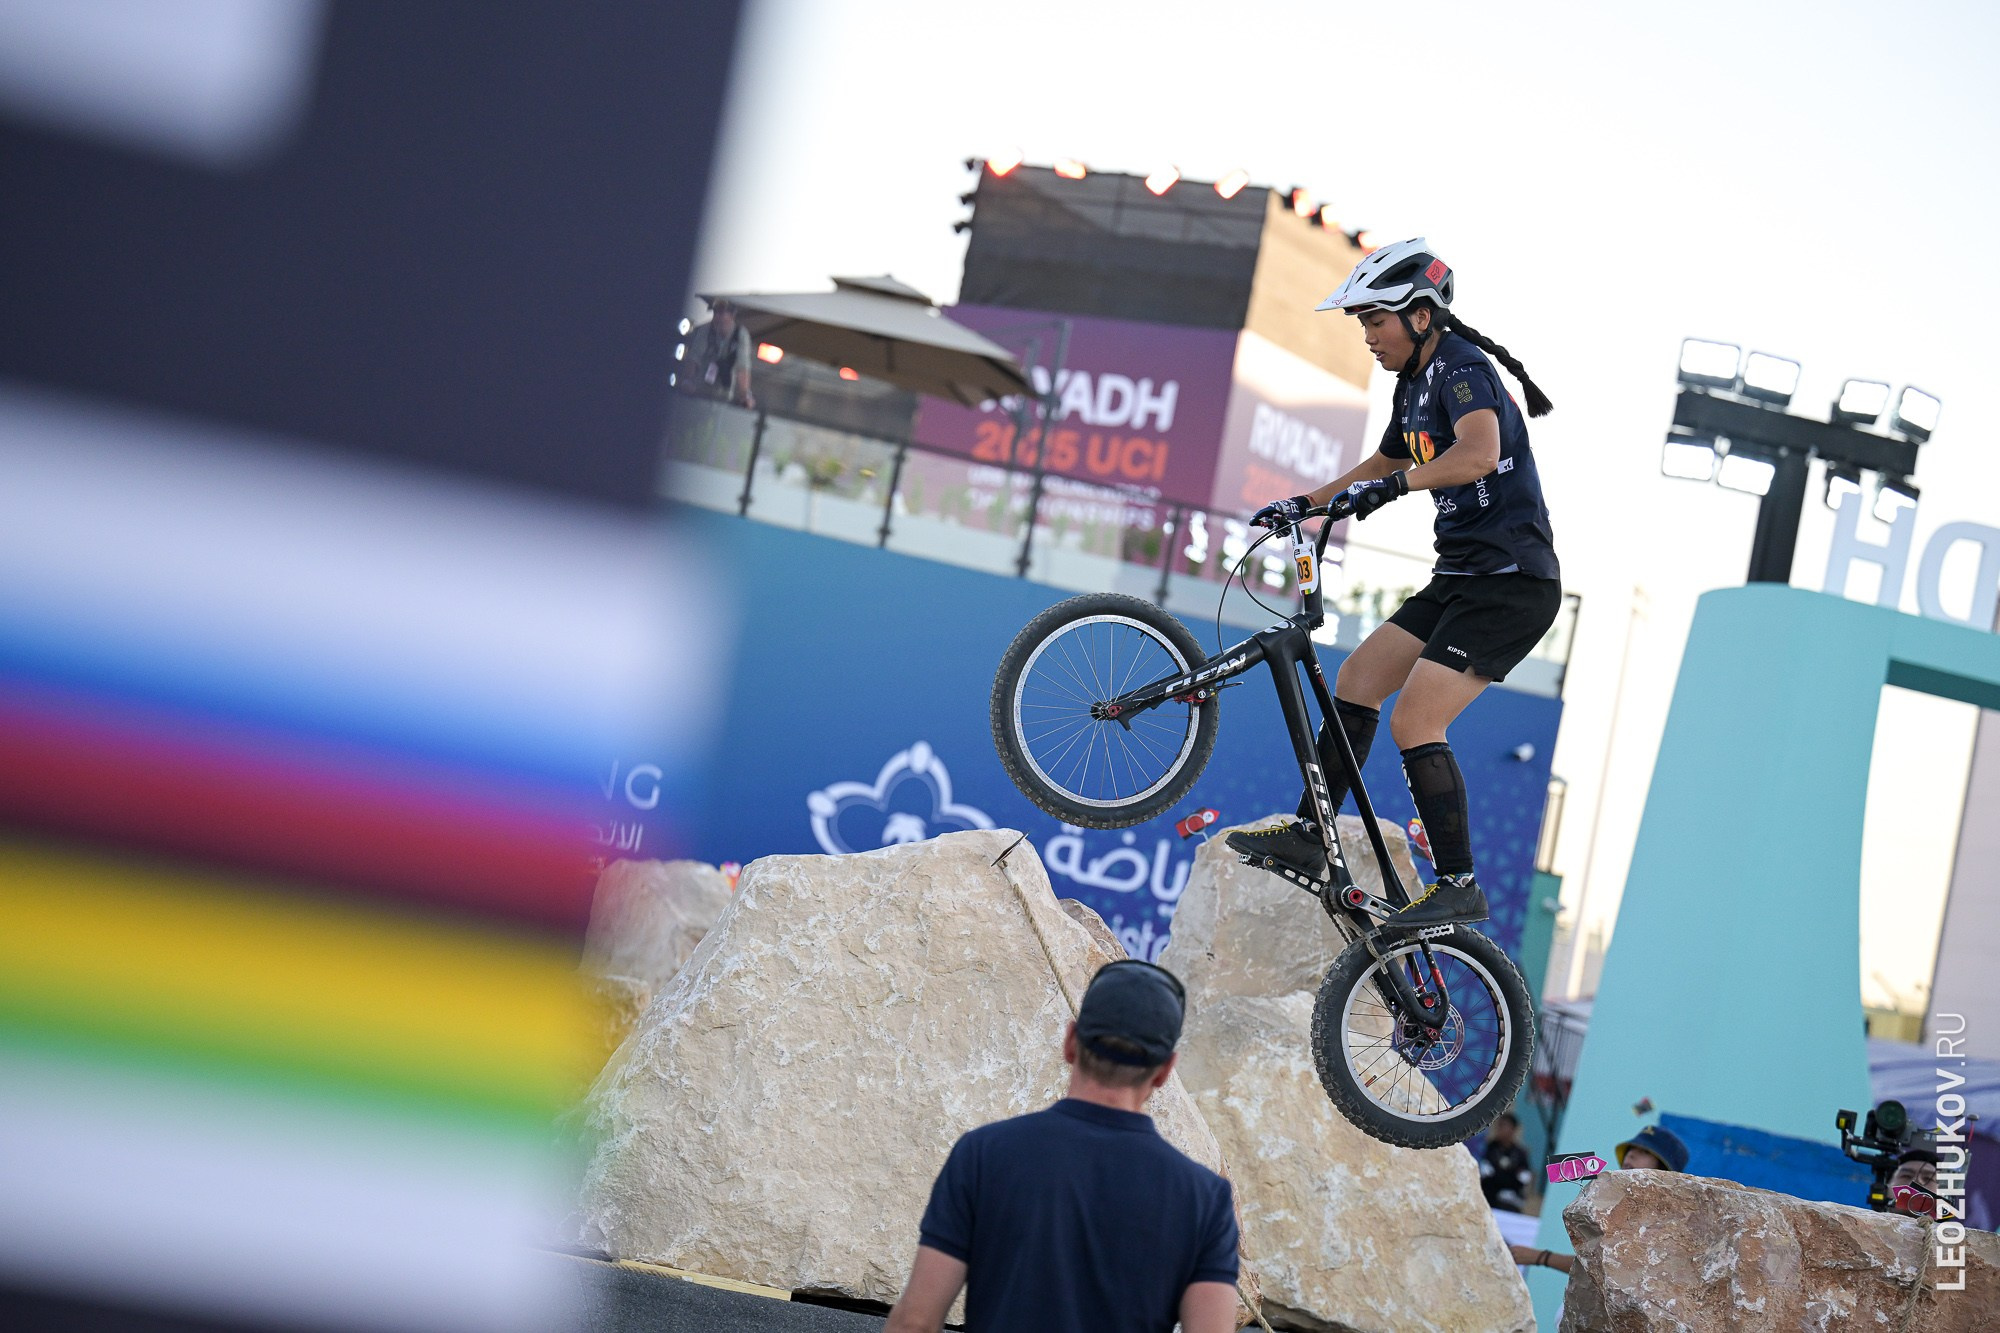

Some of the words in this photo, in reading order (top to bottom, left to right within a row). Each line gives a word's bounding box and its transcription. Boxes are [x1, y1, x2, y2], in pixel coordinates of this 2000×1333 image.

[980, 364, 1180, 433] YADH
[1453, 380, 1474, 404] ESP
[1085, 433, 1169, 482] UCI
[1402, 431, 1435, 468] SP
[1165, 652, 1247, 698] CLEAN
[1446, 645, 1468, 659] KIPSTA
[1306, 762, 1345, 869] CLEAN
